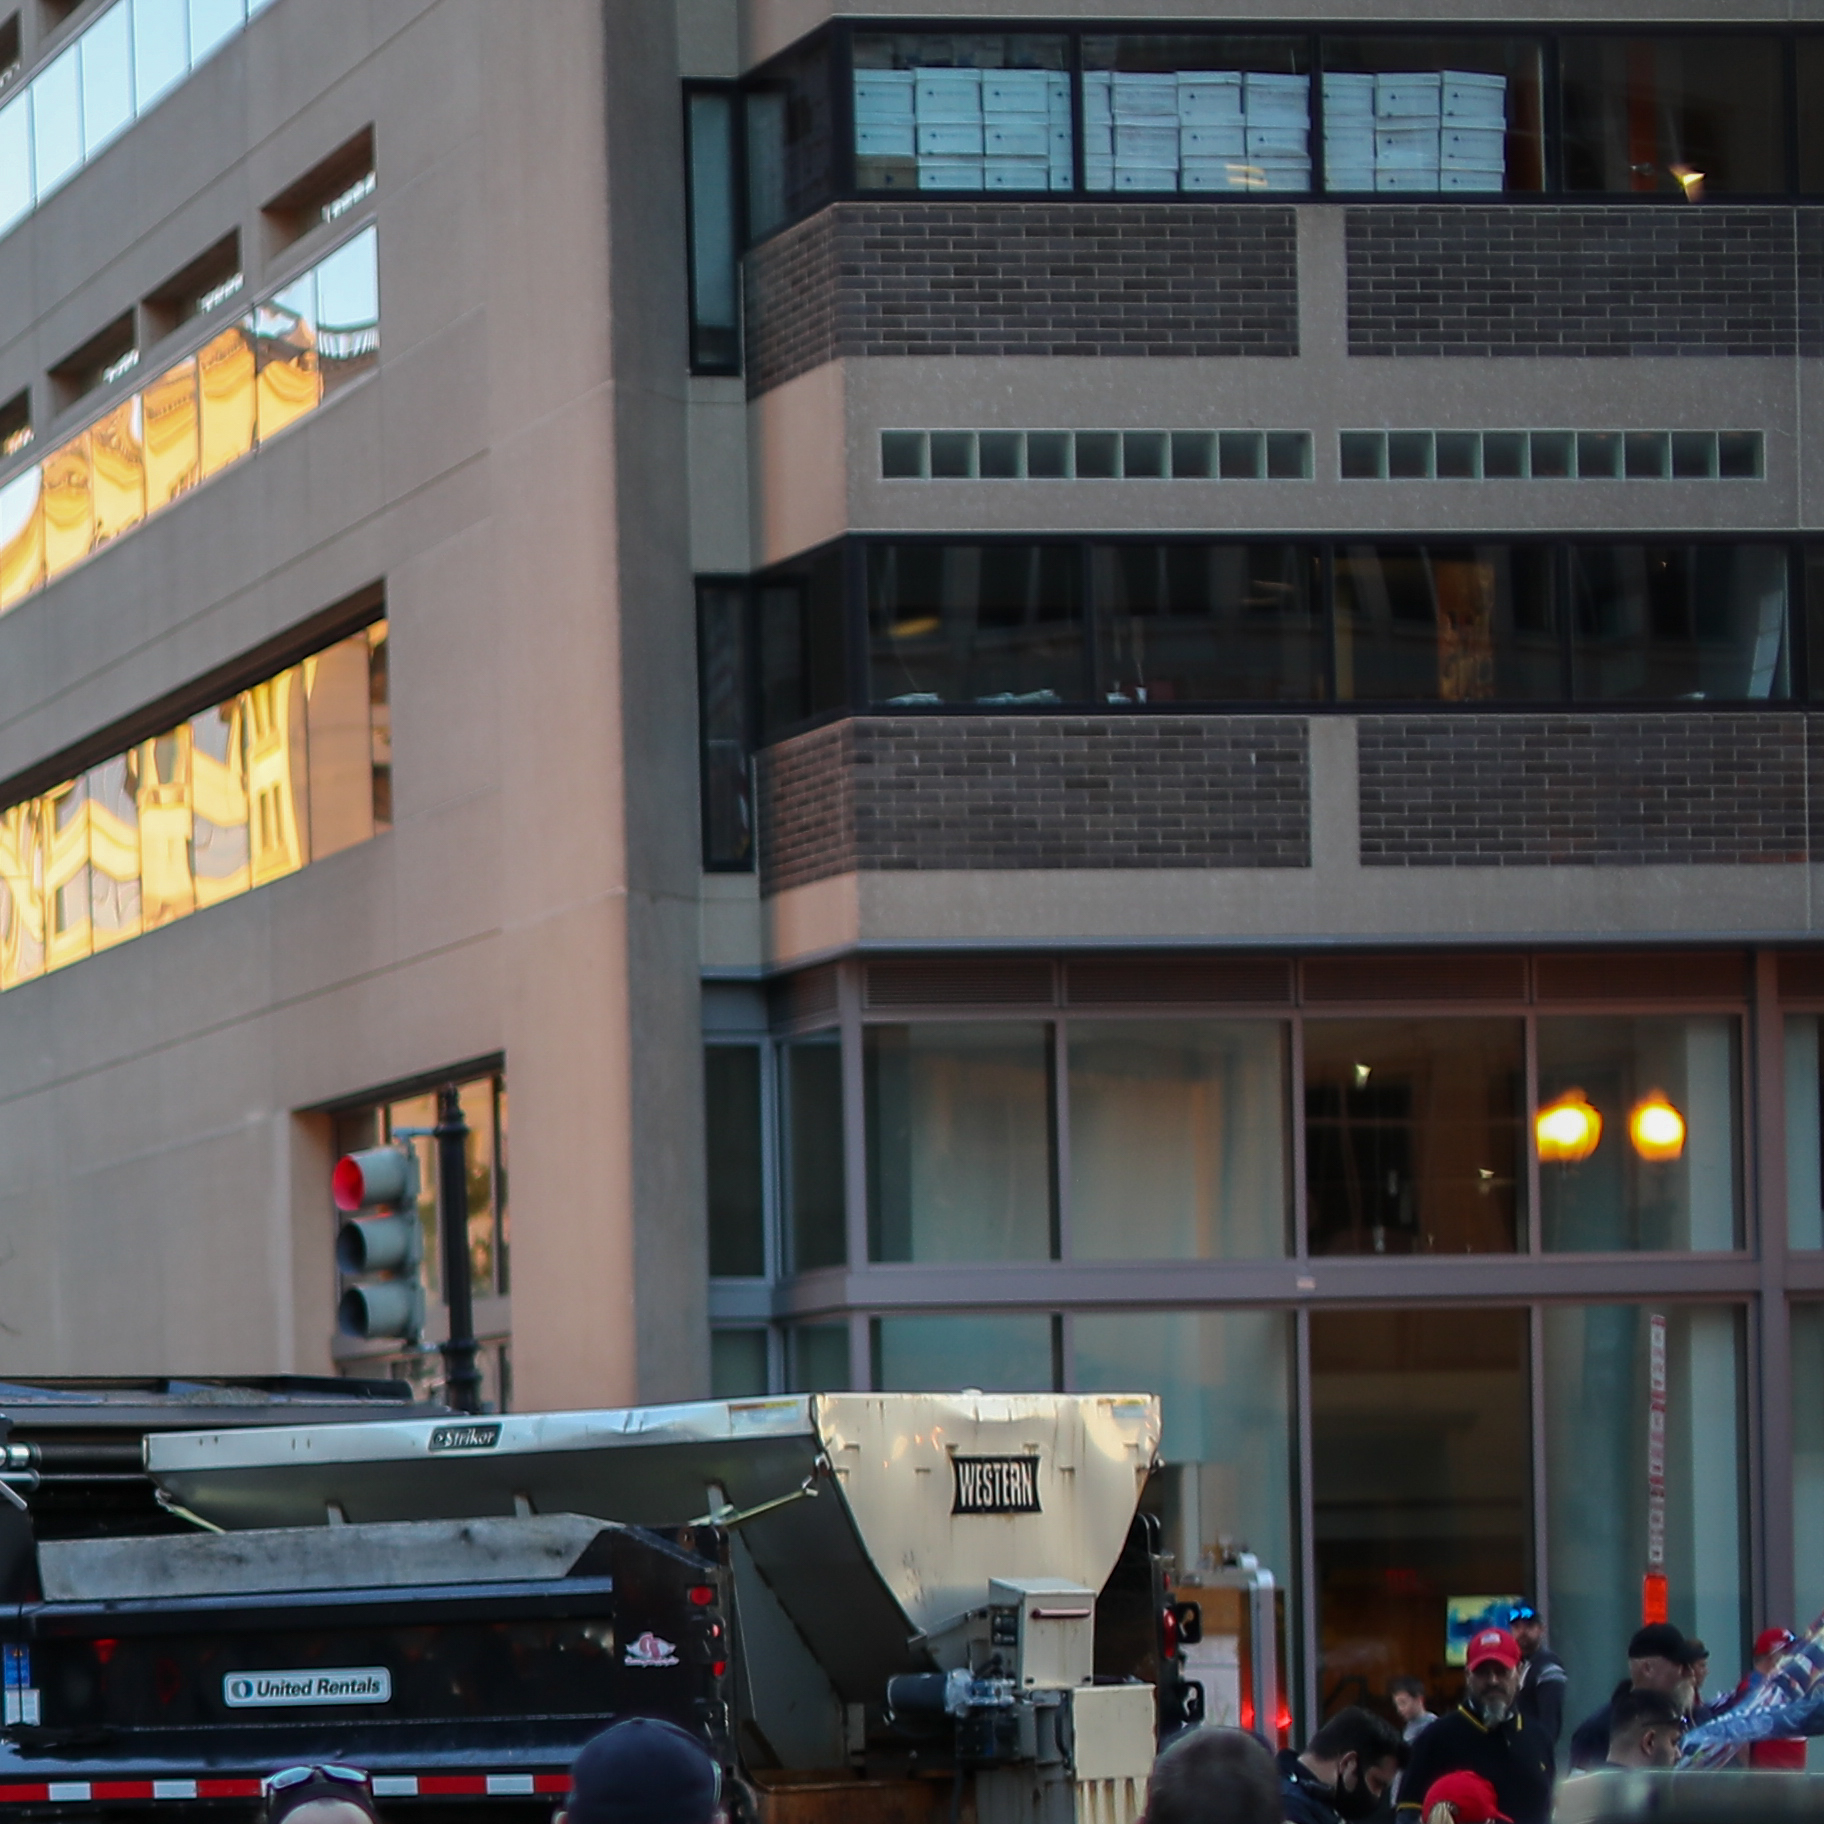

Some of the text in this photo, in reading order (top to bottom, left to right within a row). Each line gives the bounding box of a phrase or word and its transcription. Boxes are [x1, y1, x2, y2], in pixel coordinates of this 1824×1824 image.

[958, 1462, 1033, 1507] WESTERN
[256, 1676, 381, 1697] United Rentals
